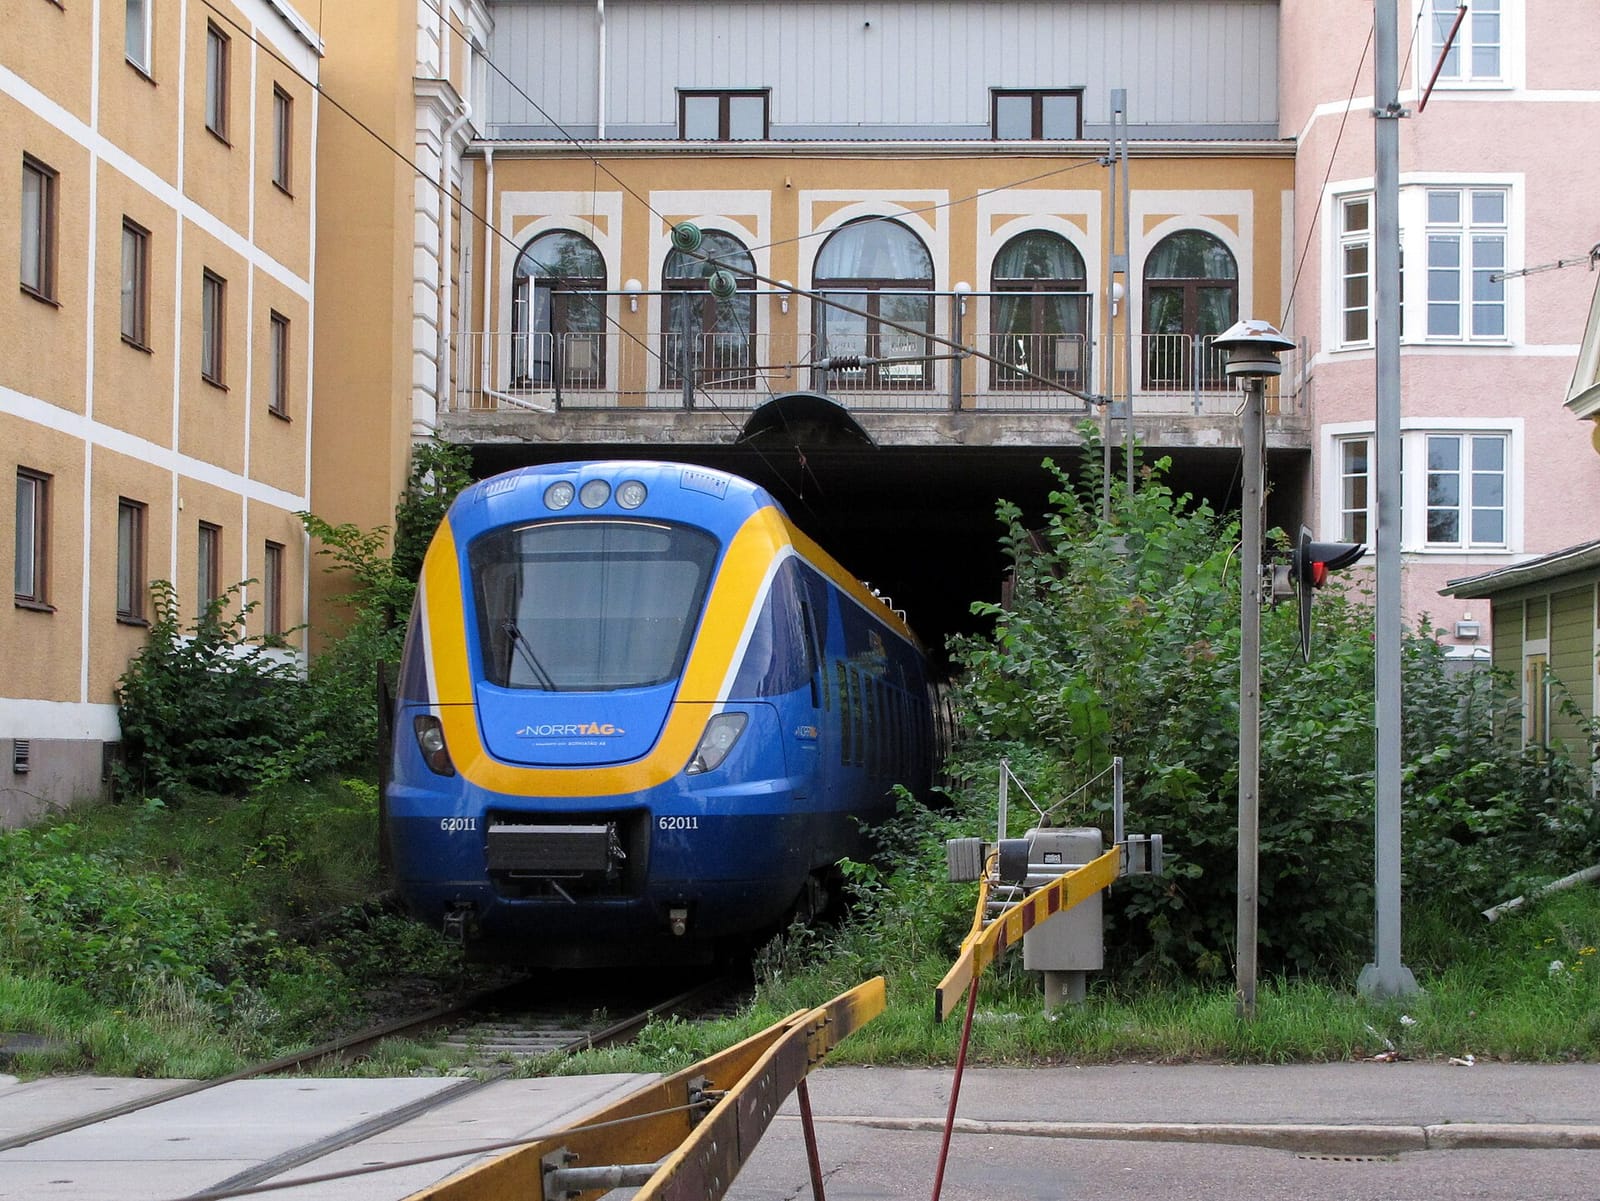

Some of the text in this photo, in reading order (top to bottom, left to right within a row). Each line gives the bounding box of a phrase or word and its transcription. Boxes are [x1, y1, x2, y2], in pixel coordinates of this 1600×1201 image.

[525, 721, 616, 736] NORRTÅG
[439, 817, 476, 831] 62011
[658, 816, 699, 830] 62011
